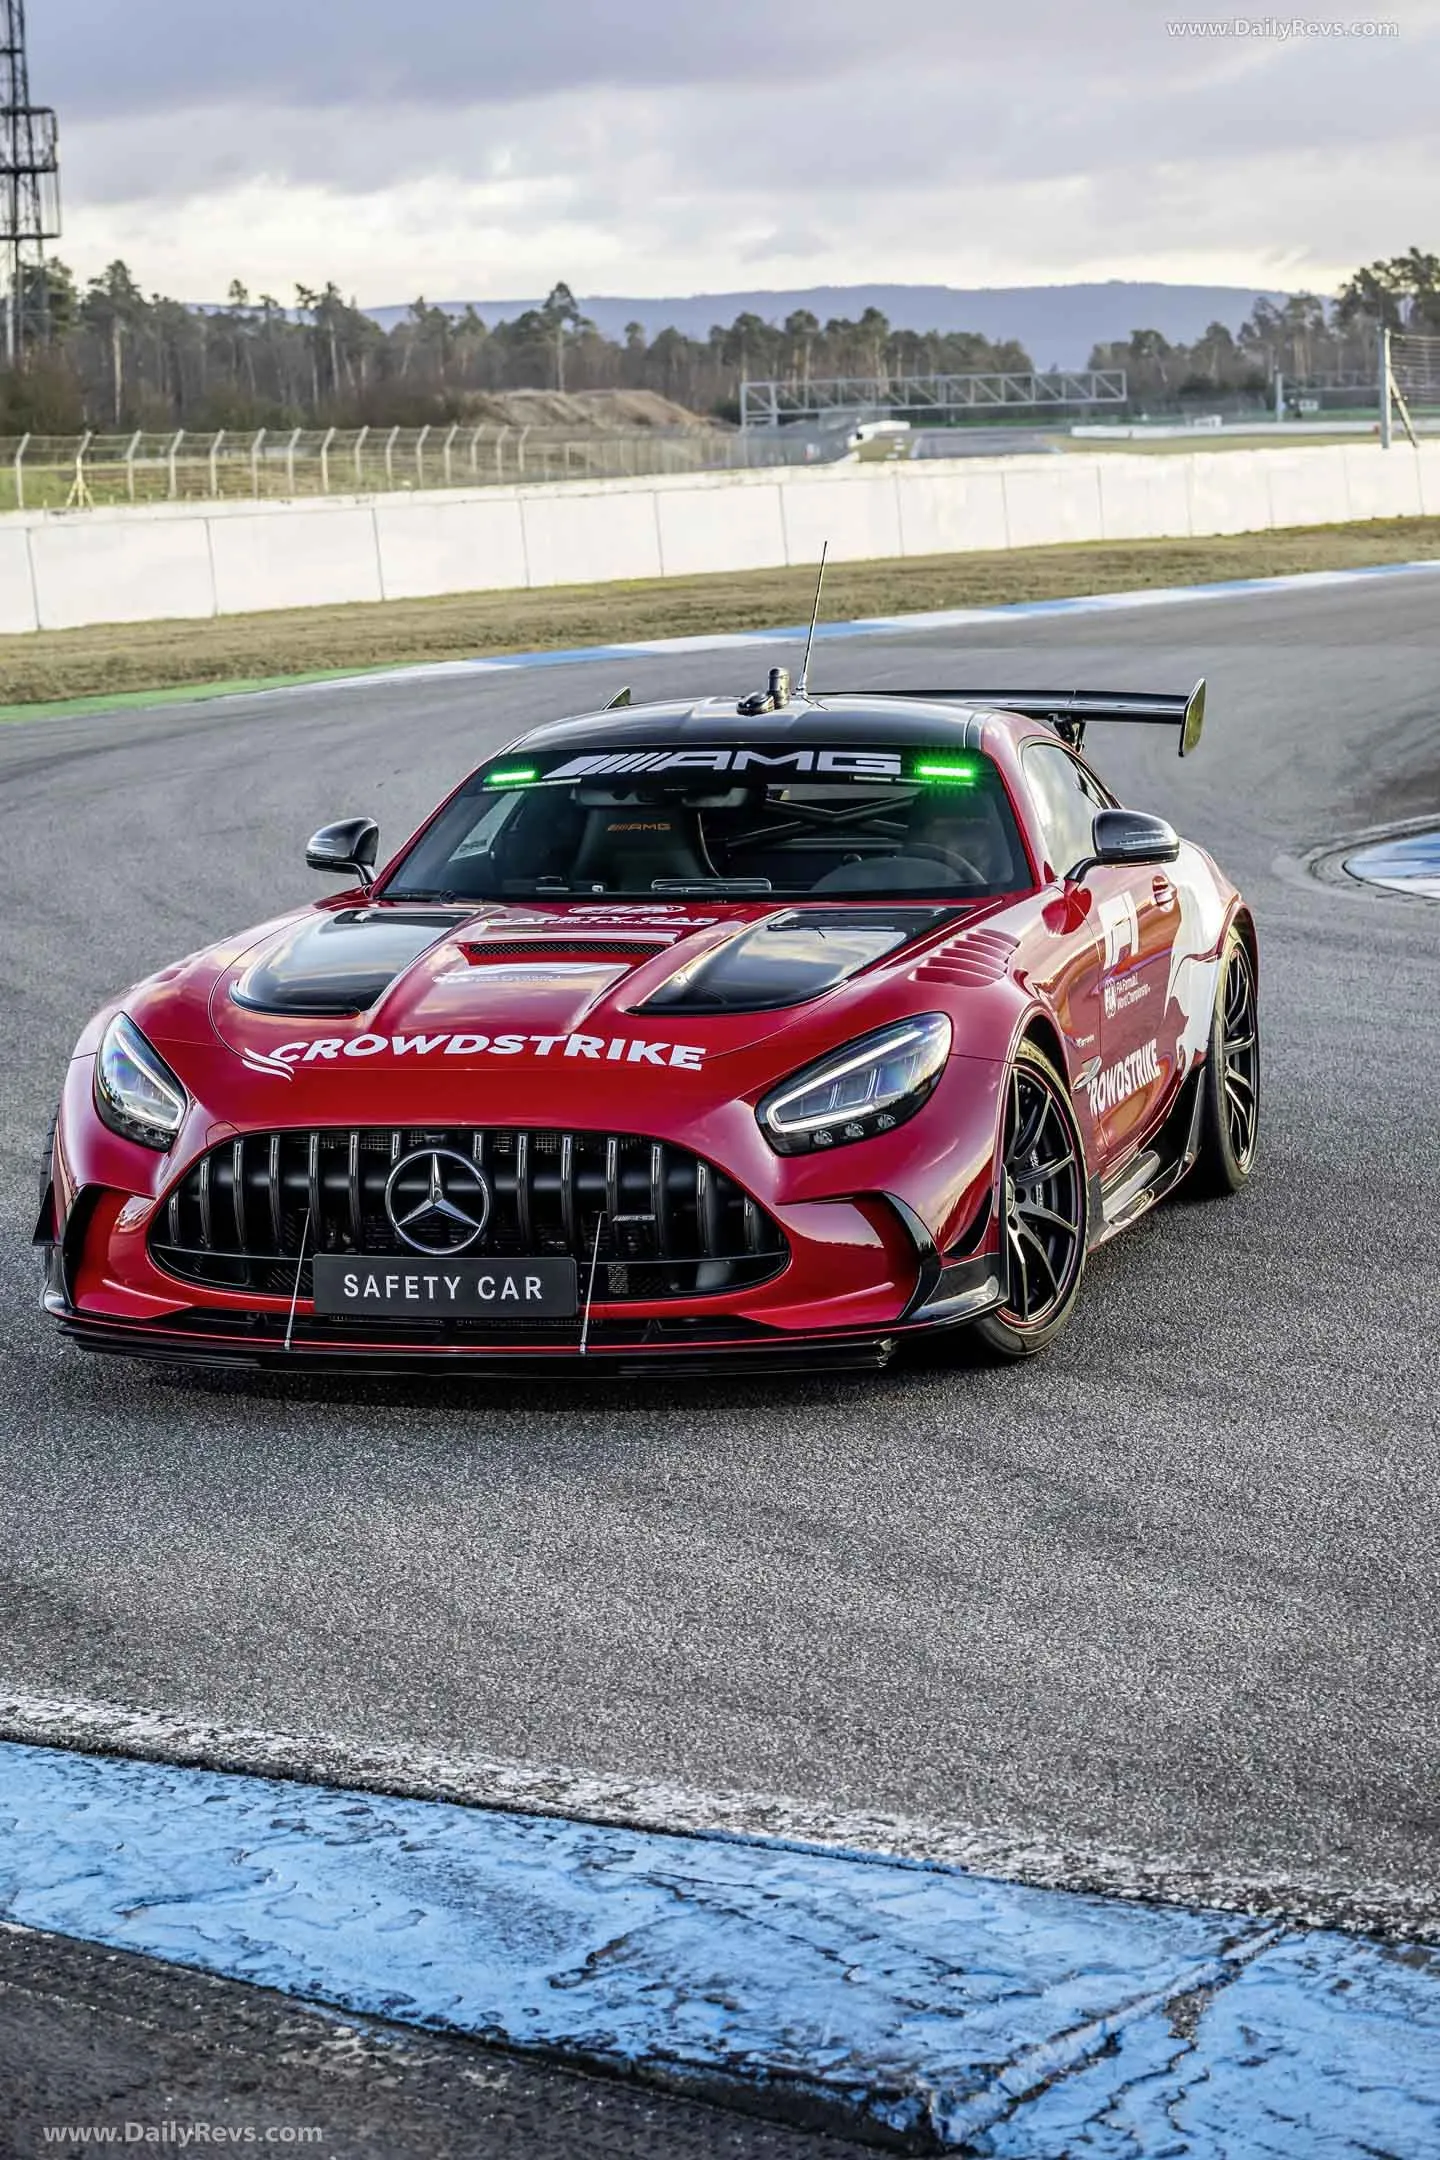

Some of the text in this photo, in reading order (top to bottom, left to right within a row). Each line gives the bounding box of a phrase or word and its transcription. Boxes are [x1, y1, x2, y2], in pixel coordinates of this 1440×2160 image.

[267, 1033, 707, 1071] CROWDSTRIKE
[1086, 1038, 1161, 1118] ROWDSTRIKE
[343, 1274, 543, 1300] SAFETY CAR
